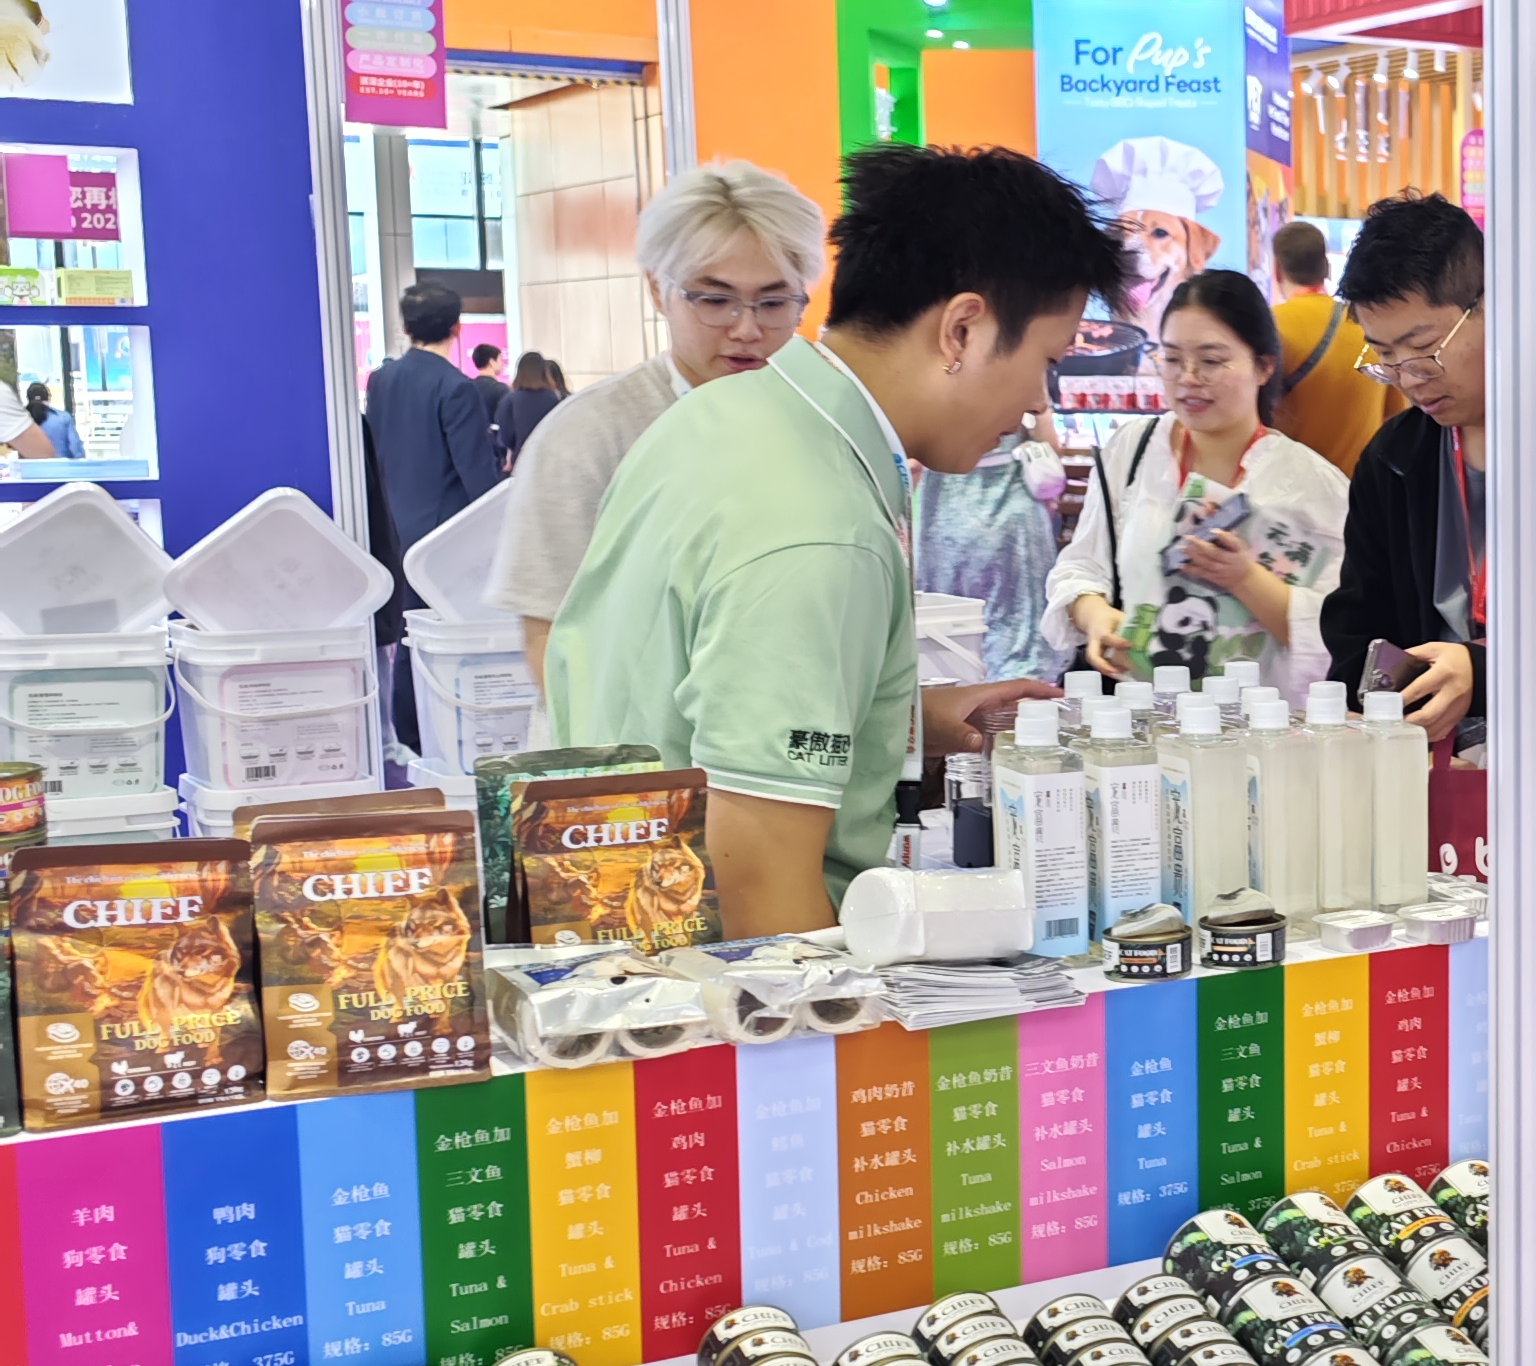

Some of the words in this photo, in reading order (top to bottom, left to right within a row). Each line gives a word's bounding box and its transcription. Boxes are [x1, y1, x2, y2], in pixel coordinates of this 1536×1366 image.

[1074, 39, 1123, 66] For
[1061, 74, 1159, 97] Backyard
[1165, 75, 1221, 93] Feast
[561, 817, 669, 850] CHIEF
[301, 867, 434, 903] CHIEF
[62, 895, 205, 931] CHIEF
[652, 916, 709, 936] PRICE
[337, 992, 396, 1011] FULL
[404, 981, 471, 1003] PRICE
[370, 1006, 404, 1022] DOG
[405, 1000, 446, 1016] FOOD
[100, 1021, 160, 1041] FULL
[172, 1009, 242, 1033] PRICE
[134, 1036, 170, 1052] DOG
[172, 1030, 217, 1047] FOOD
[1024, 1052, 1099, 1077] 三文鱼奶昔
[935, 1065, 1014, 1092] 金枪鱼奶昔
[850, 1081, 916, 1105] 鸡肉奶昔
[434, 1126, 511, 1153] 金枪鱼加
[670, 1132, 706, 1152] 鸡肉
[564, 1149, 602, 1169] 蟹柳
[852, 1148, 917, 1173] 补水罐头
[1040, 1154, 1087, 1173] Salmon
[1137, 1154, 1167, 1171] Tuna
[445, 1165, 503, 1188] 三文鱼
[330, 1182, 391, 1207] 金枪鱼
[1158, 1181, 1188, 1198] 375G
[71, 1204, 115, 1227] 羊肉
[212, 1202, 256, 1225] 鸭肉
[940, 1200, 1012, 1224] milkshake
[332, 1219, 392, 1244] 猫零食
[848, 1216, 923, 1241] milkshake
[62, 1242, 128, 1269] 狗零食
[205, 1239, 268, 1265] 狗零食
[74, 1284, 120, 1307] 罐头
[216, 1279, 260, 1302] 罐头
[449, 1279, 488, 1298] Tuna
[659, 1273, 723, 1295] Chicken
[345, 1298, 386, 1316] Tuna
[540, 1298, 579, 1317] Crab
[588, 1288, 634, 1307] stick
[176, 1313, 303, 1348] Duck&Chicken
[450, 1313, 509, 1335] Salmon
[381, 1329, 412, 1347] 85G
